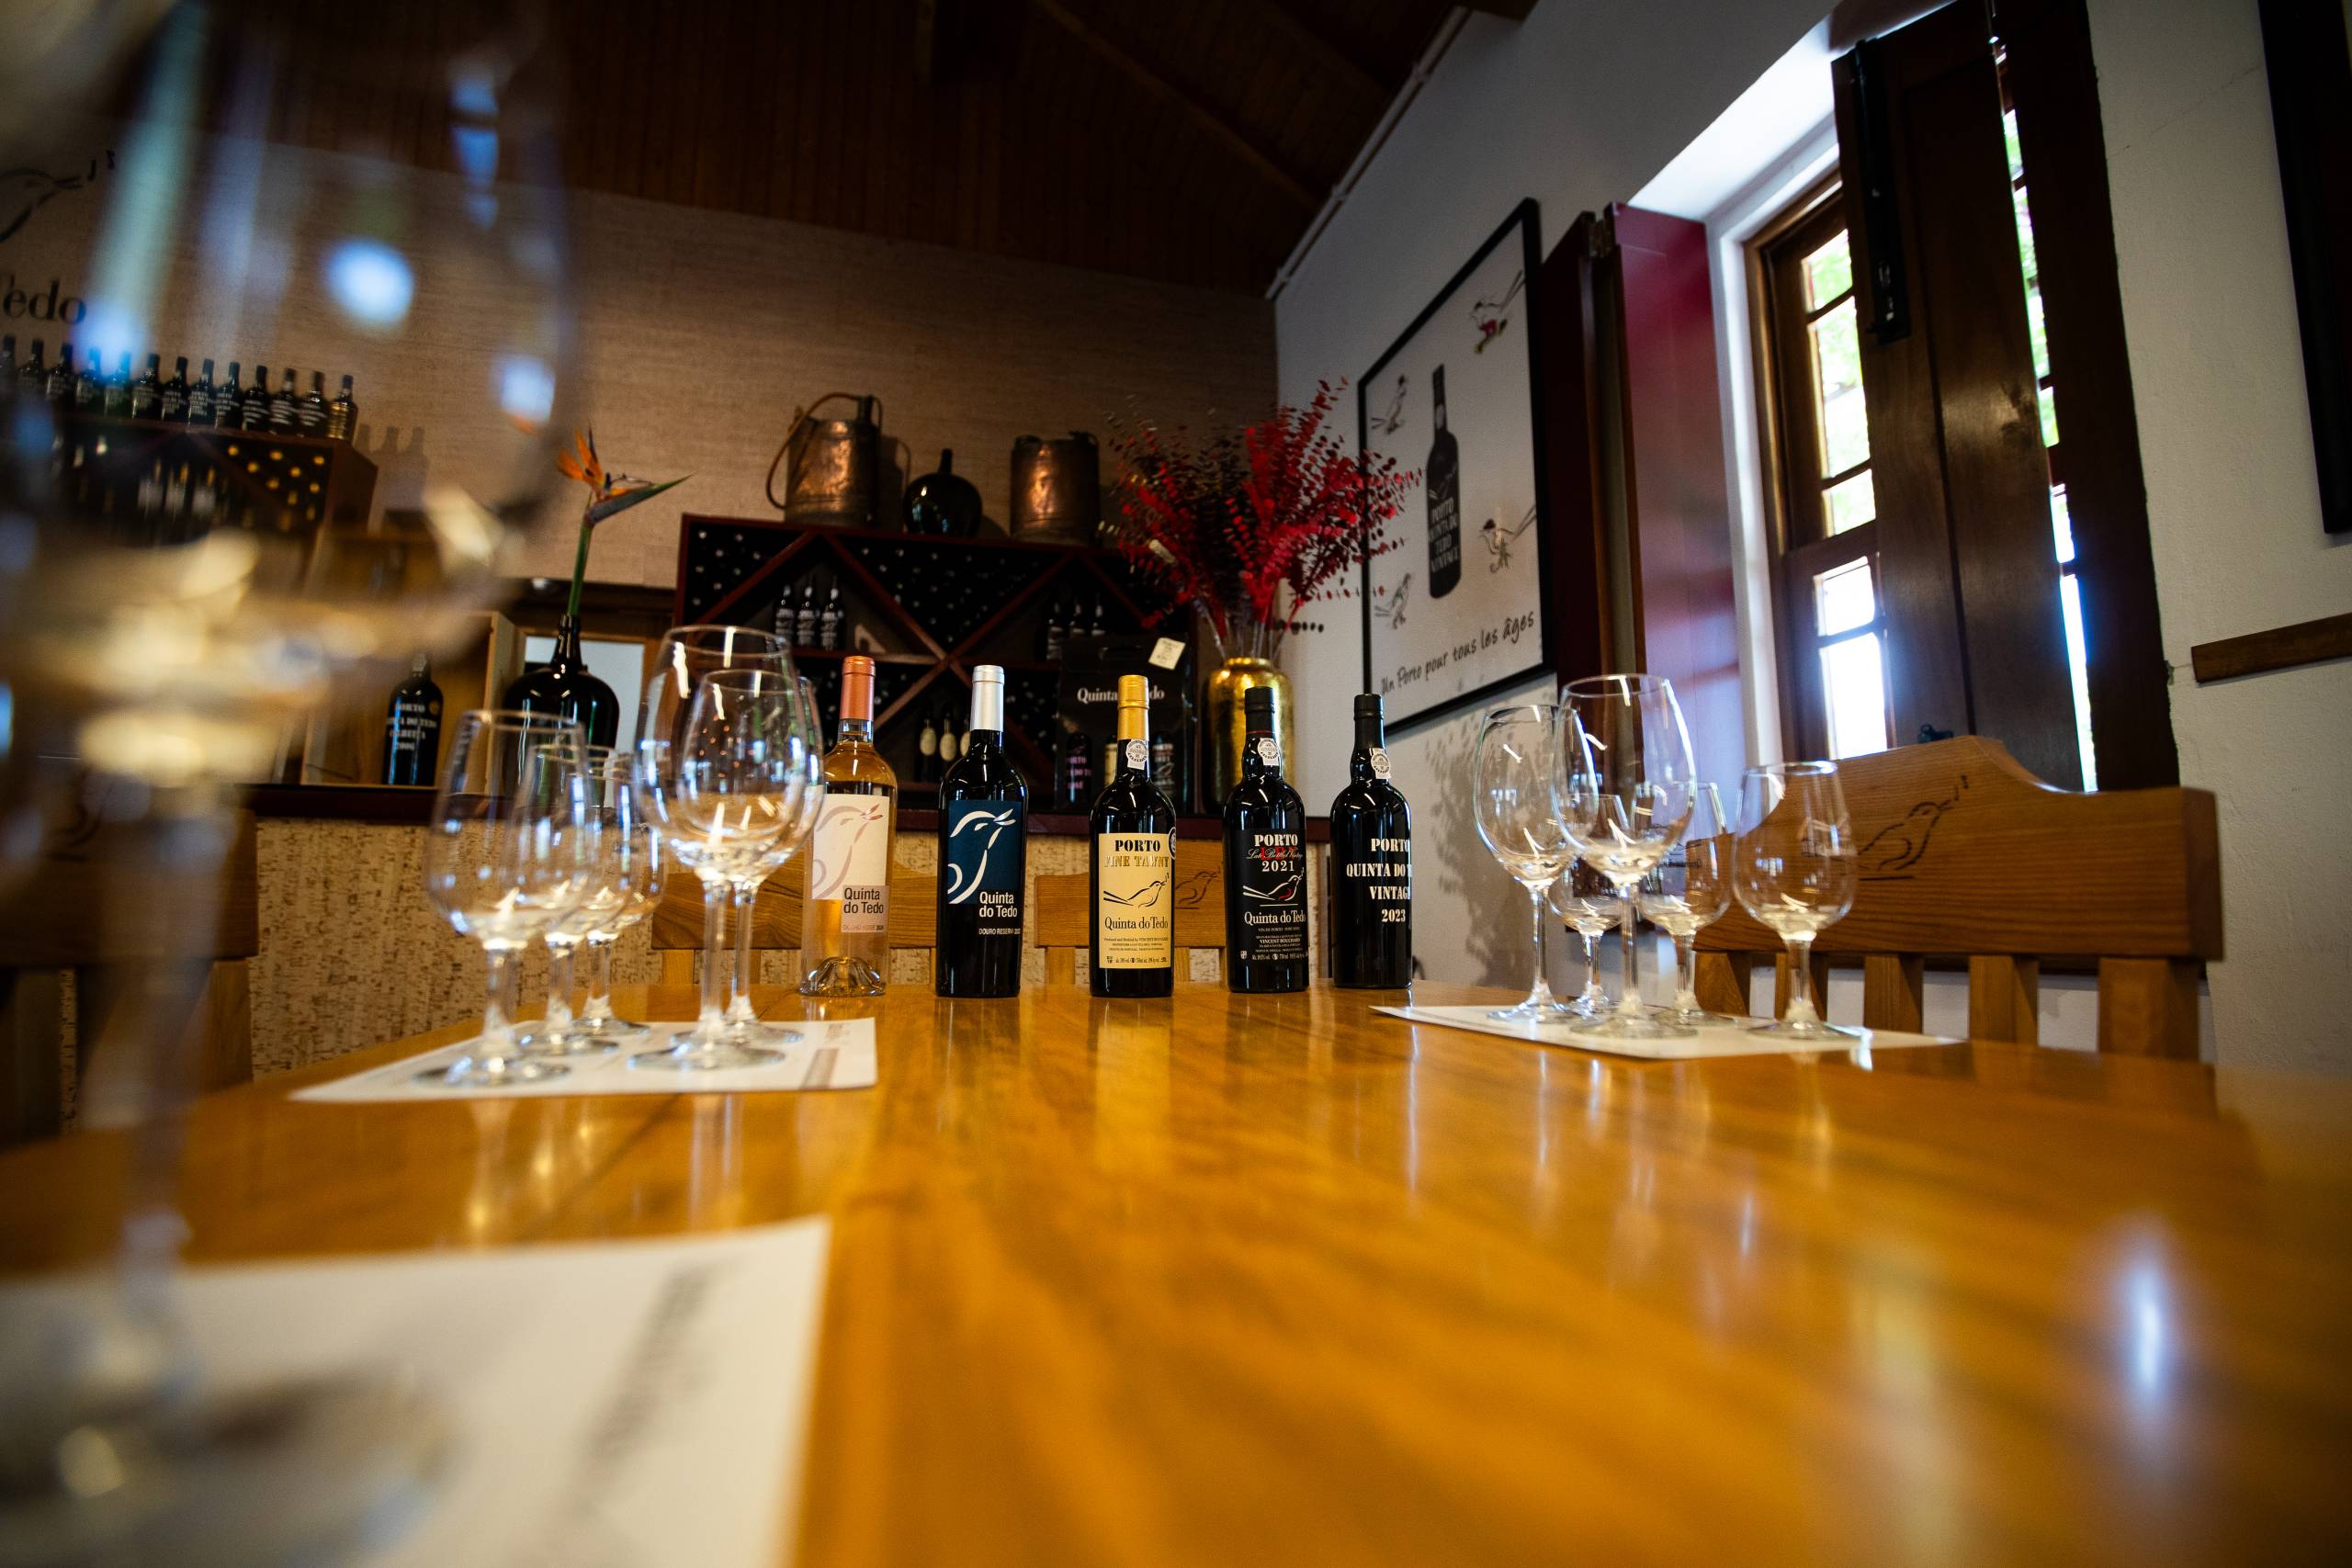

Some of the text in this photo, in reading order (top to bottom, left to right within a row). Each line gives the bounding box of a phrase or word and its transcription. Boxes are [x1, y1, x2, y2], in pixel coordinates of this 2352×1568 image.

[3, 273, 86, 325] edo
[1397, 666, 1422, 687] Porto
[1425, 650, 1449, 681] pour
[1453, 638, 1477, 661] tous
[1481, 629, 1498, 649] les
[1502, 611, 1534, 644] âges
[1077, 685, 1166, 704] Quinta do
[1114, 840, 1161, 852] PORTO
[1253, 833, 1298, 846] PORTO
[1371, 838, 1411, 852] PORTO
[1261, 860, 1295, 872] 2021
[1346, 863, 1391, 877] QUINTA
[1394, 863, 1406, 877] DO
[843, 887, 880, 900] Quinta
[979, 891, 1014, 905] Quinta
[1369, 886, 1411, 900] VINTAGE
[843, 901, 885, 914] do Tedo
[978, 905, 1018, 918] do Tedo
[1244, 909, 1306, 926] Quinta do Tedo
[1381, 908, 1406, 922] 2023
[1104, 916, 1169, 931] Quinta do Tedo
